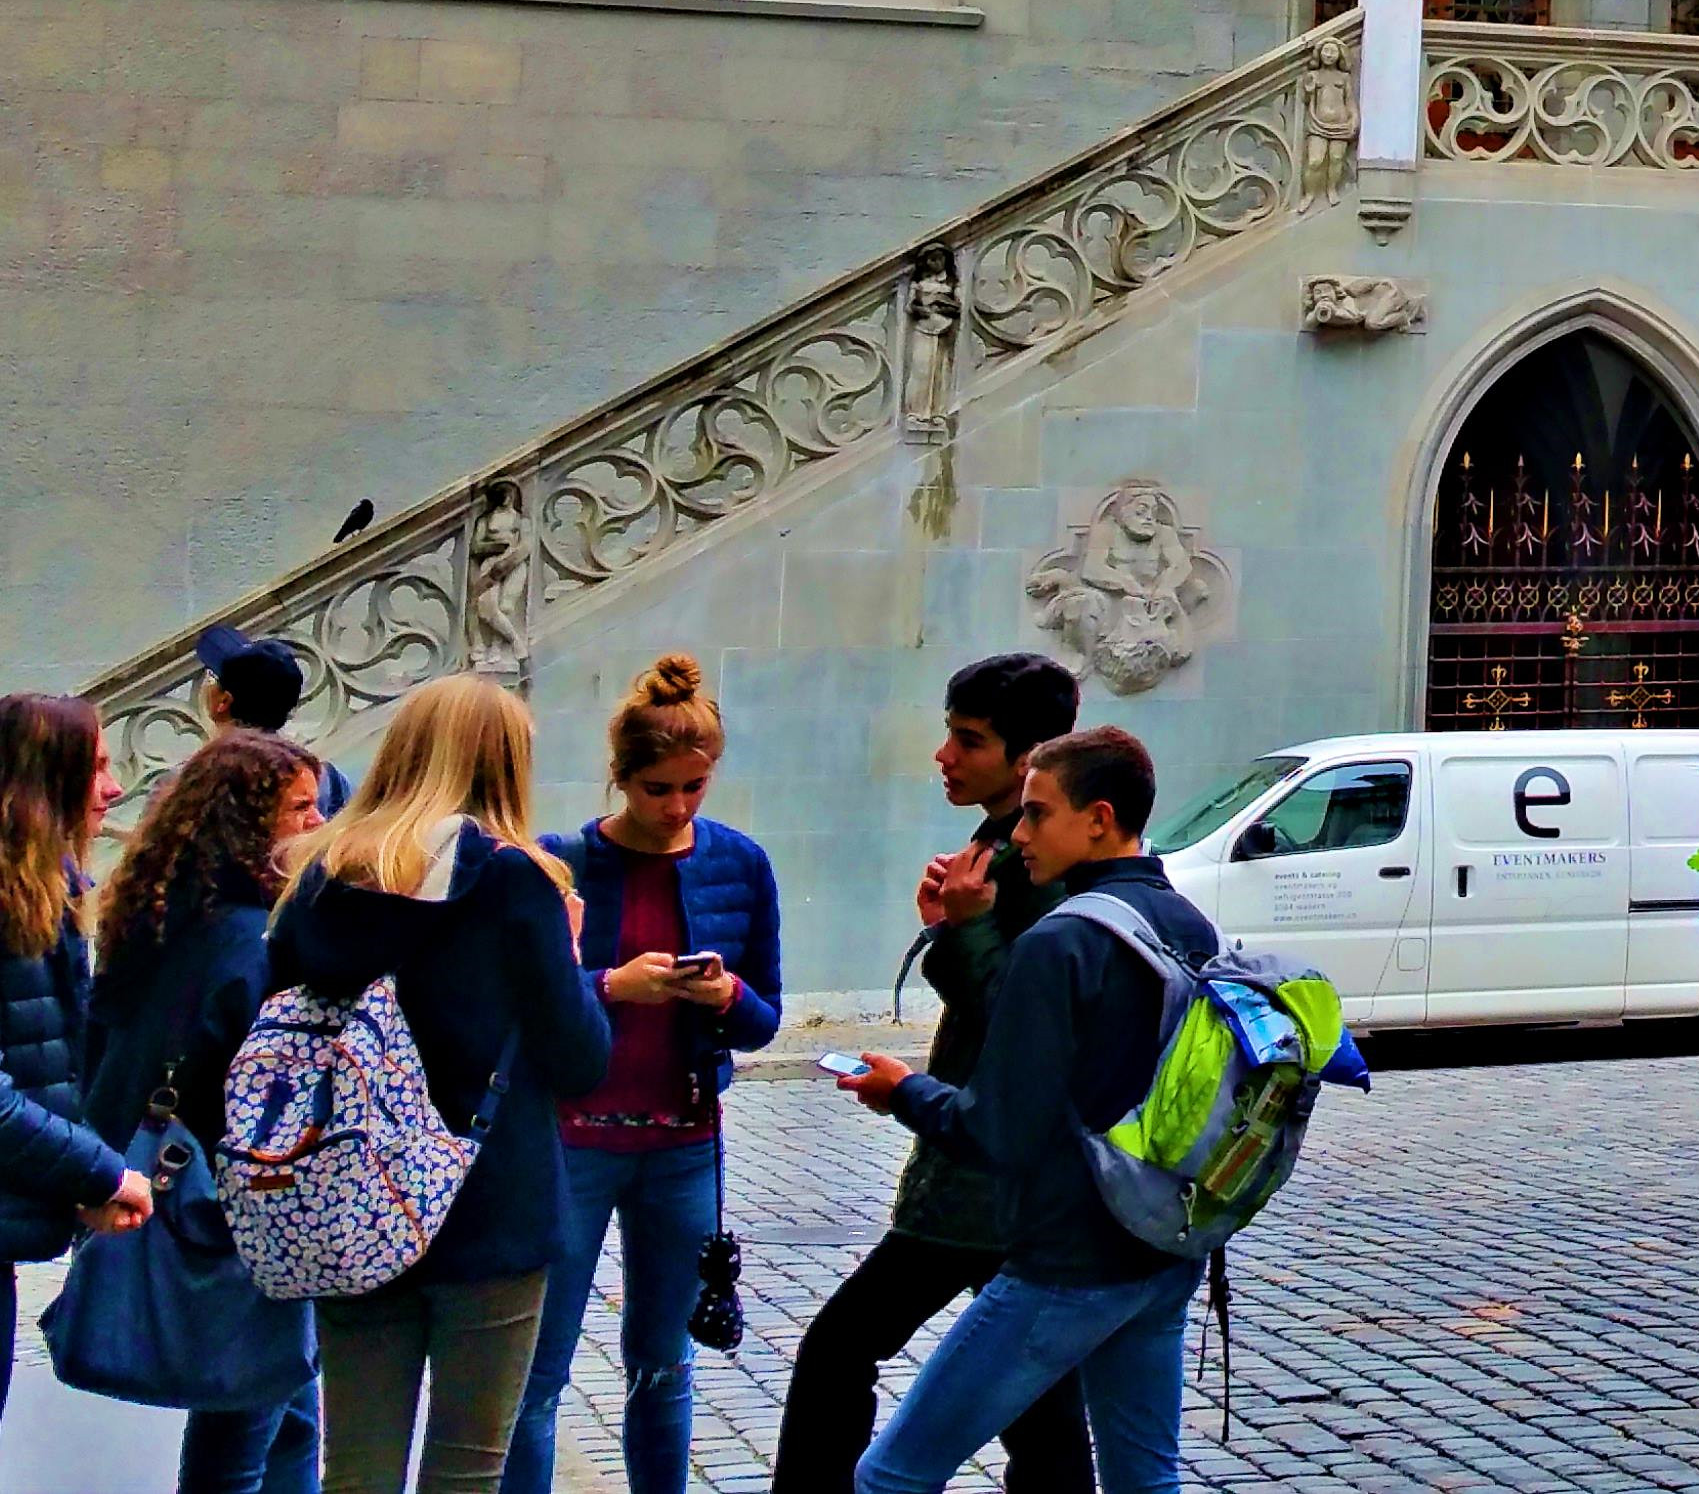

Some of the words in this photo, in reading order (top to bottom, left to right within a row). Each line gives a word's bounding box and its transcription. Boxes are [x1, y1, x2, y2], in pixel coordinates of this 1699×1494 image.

[1513, 766, 1571, 839] e
[1493, 851, 1607, 866] EVENTMAKERS
[1274, 872, 1299, 880] events
[1302, 871, 1308, 879] &
[1310, 871, 1341, 879] catering
